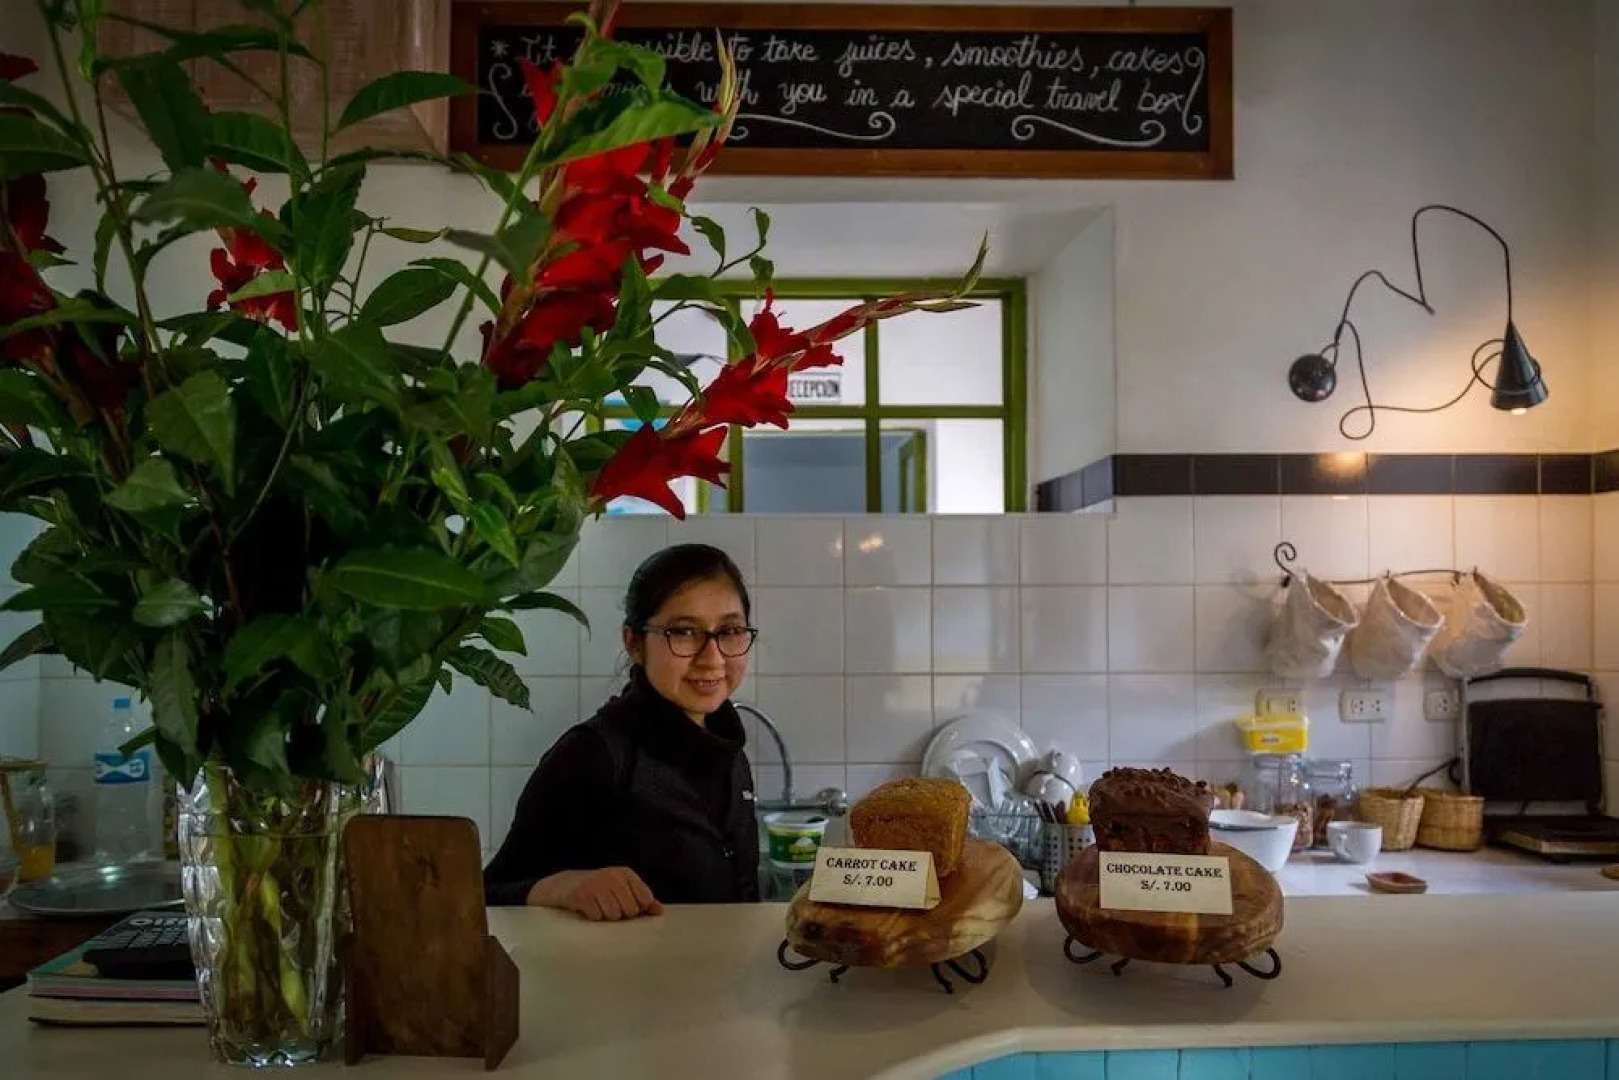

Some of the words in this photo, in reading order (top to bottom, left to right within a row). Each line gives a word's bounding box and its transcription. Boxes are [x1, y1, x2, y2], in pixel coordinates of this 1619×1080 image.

[727, 32, 755, 62] to
[760, 35, 820, 62] take
[777, 80, 828, 116] you
[848, 80, 878, 106] in
[889, 89, 916, 108] a
[932, 71, 1036, 117] special
[1043, 77, 1122, 112] travel
[1137, 81, 1185, 114] box
[826, 857, 878, 869] CARROT
[879, 859, 918, 872] CAKE
[1106, 862, 1183, 877] CHOCOLATE
[1184, 866, 1224, 879] CAKE
[1163, 881, 1192, 892] 7.00
